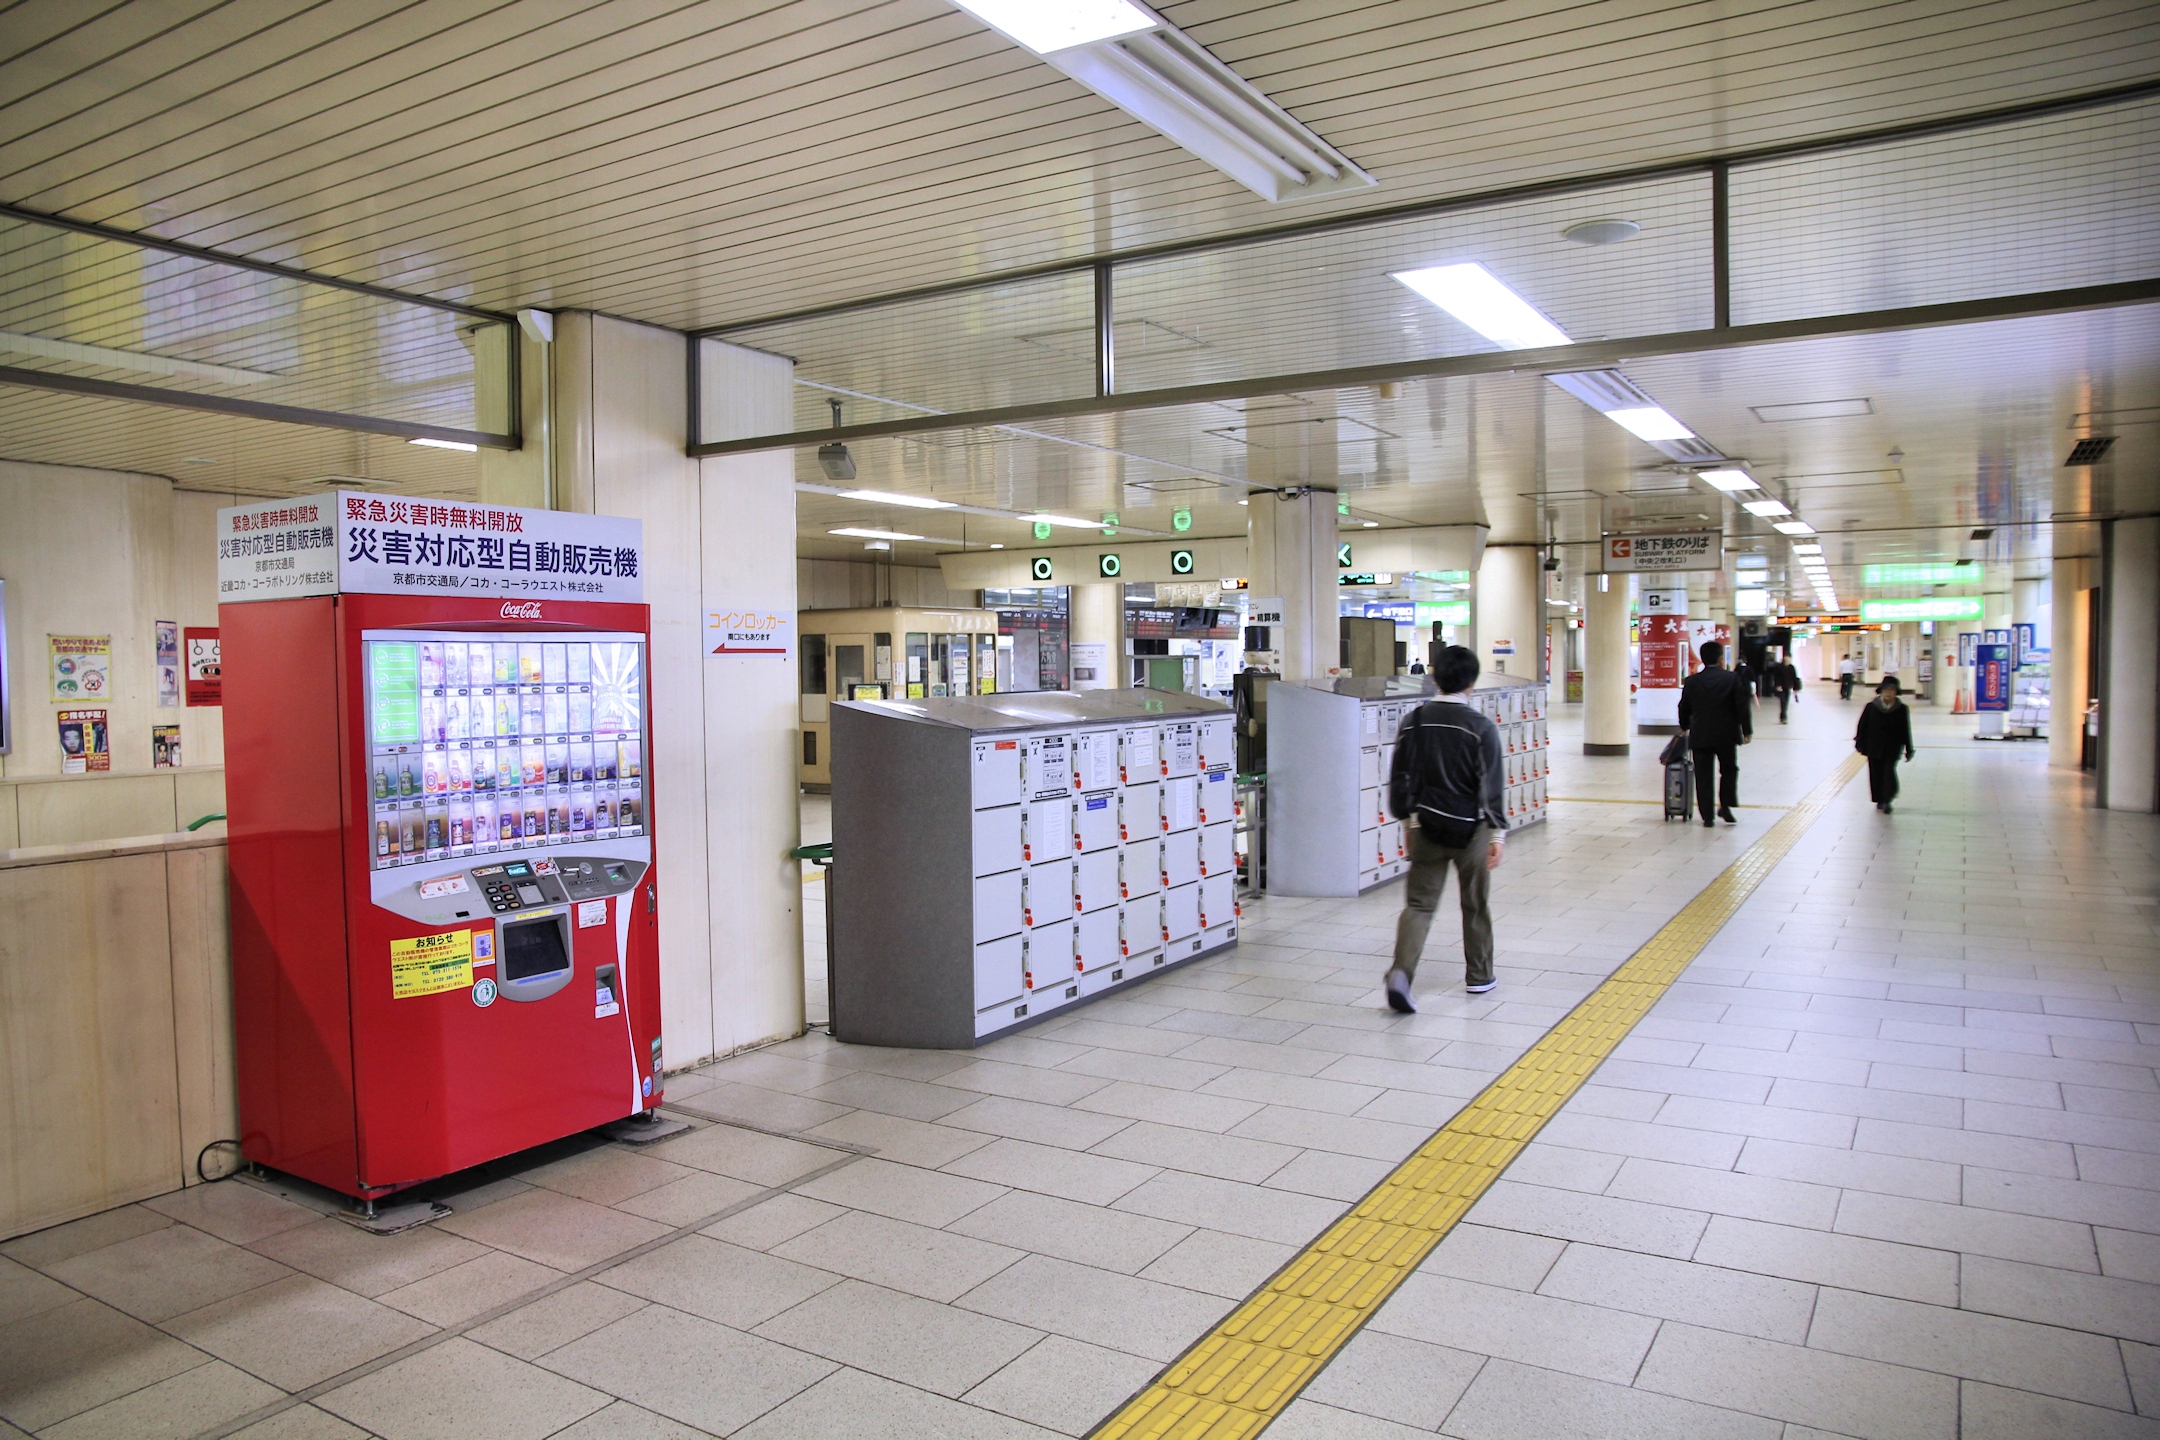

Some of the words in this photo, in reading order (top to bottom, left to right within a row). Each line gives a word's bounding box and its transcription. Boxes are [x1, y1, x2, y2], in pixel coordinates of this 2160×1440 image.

[232, 504, 319, 533] 緊急災害時無料開放
[346, 497, 524, 533] 緊急災害時無料開放
[220, 525, 334, 560] 災害対応型自動販売機
[1634, 536, 1710, 551] 地下鉄のりば
[348, 527, 638, 578] 災害対応型自動販売機
[255, 557, 295, 573] 京都市交通局
[220, 570, 334, 593] 近畿コカ・コーラボトリング株式会社
[393, 572, 604, 594] 京都市交通局／コカ・コーラウエスト株式会社
[500, 601, 543, 619] Coca-Cola
[1257, 612, 1281, 623] 精算機
[709, 612, 787, 630] コインロッカー
[1640, 617, 1653, 636] 学
[727, 633, 770, 641] 南口にもあります
[416, 933, 453, 948] お知らせ
